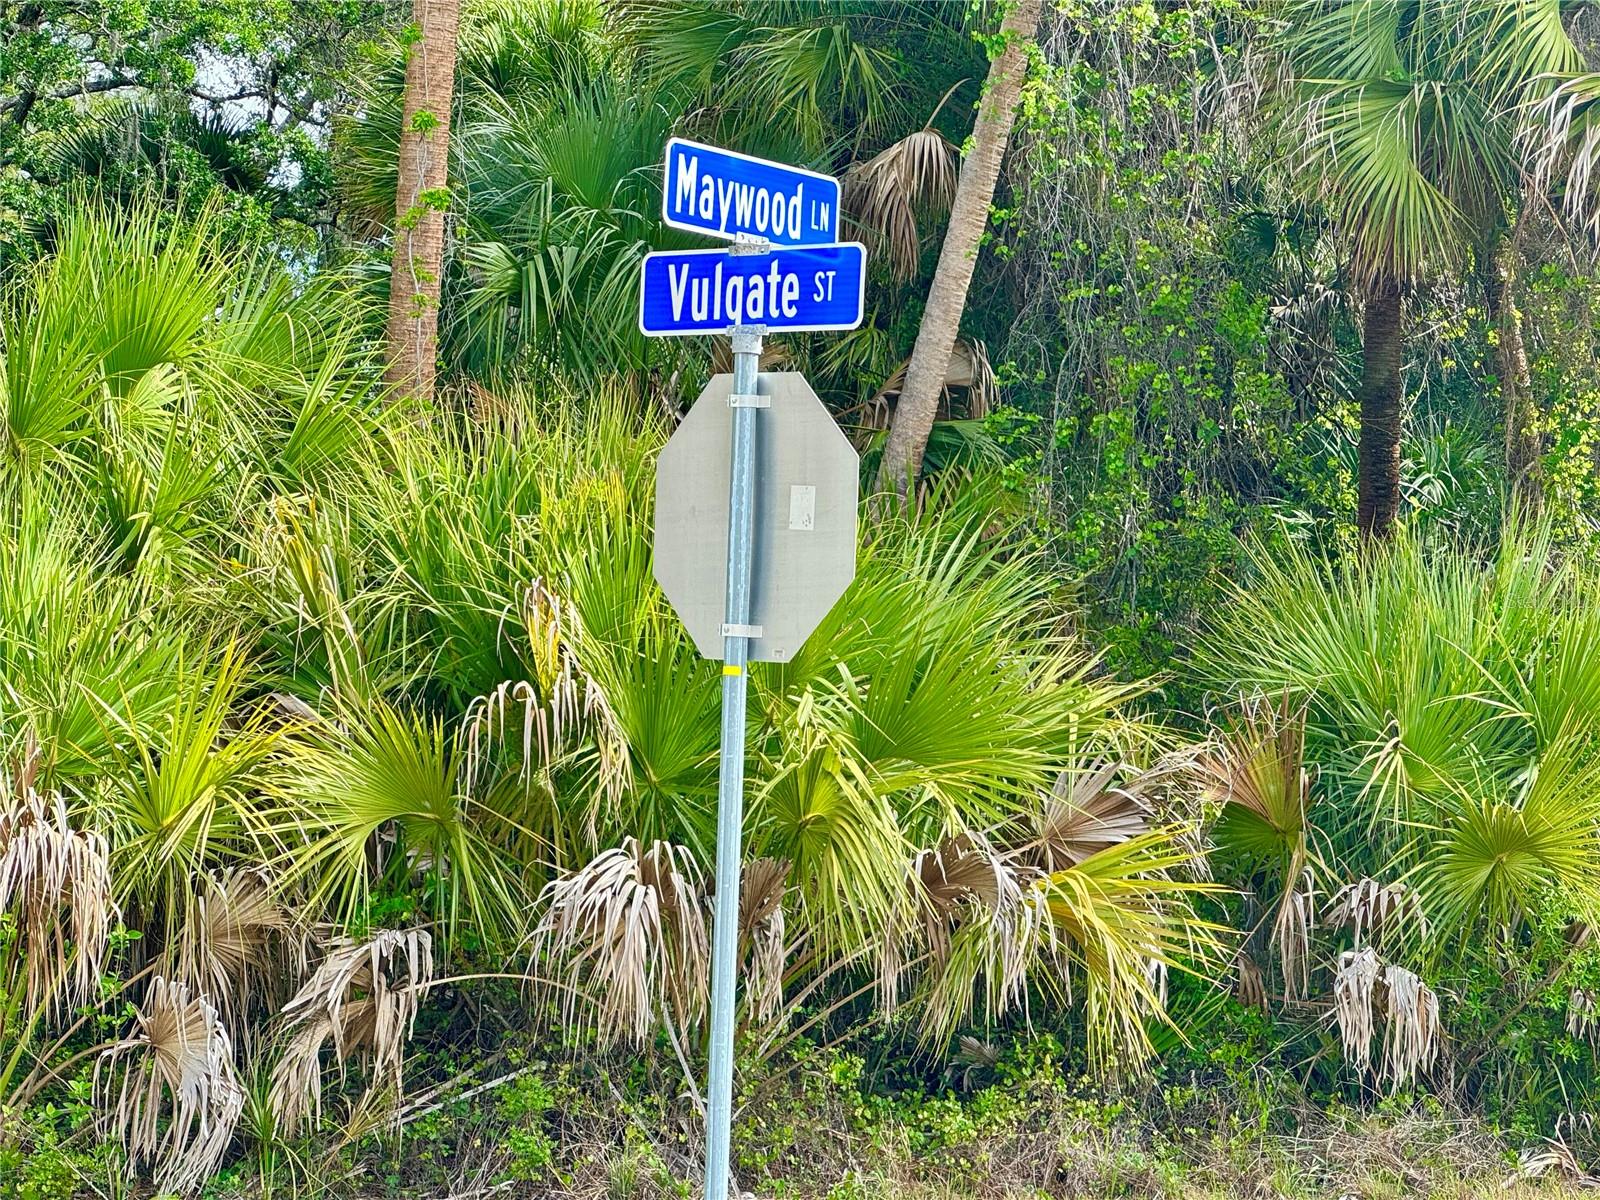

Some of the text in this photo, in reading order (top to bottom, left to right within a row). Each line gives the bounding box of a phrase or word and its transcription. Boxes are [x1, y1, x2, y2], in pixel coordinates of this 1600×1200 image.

[675, 153, 830, 240] Maywood LN
[668, 259, 837, 325] Vulgate ST
